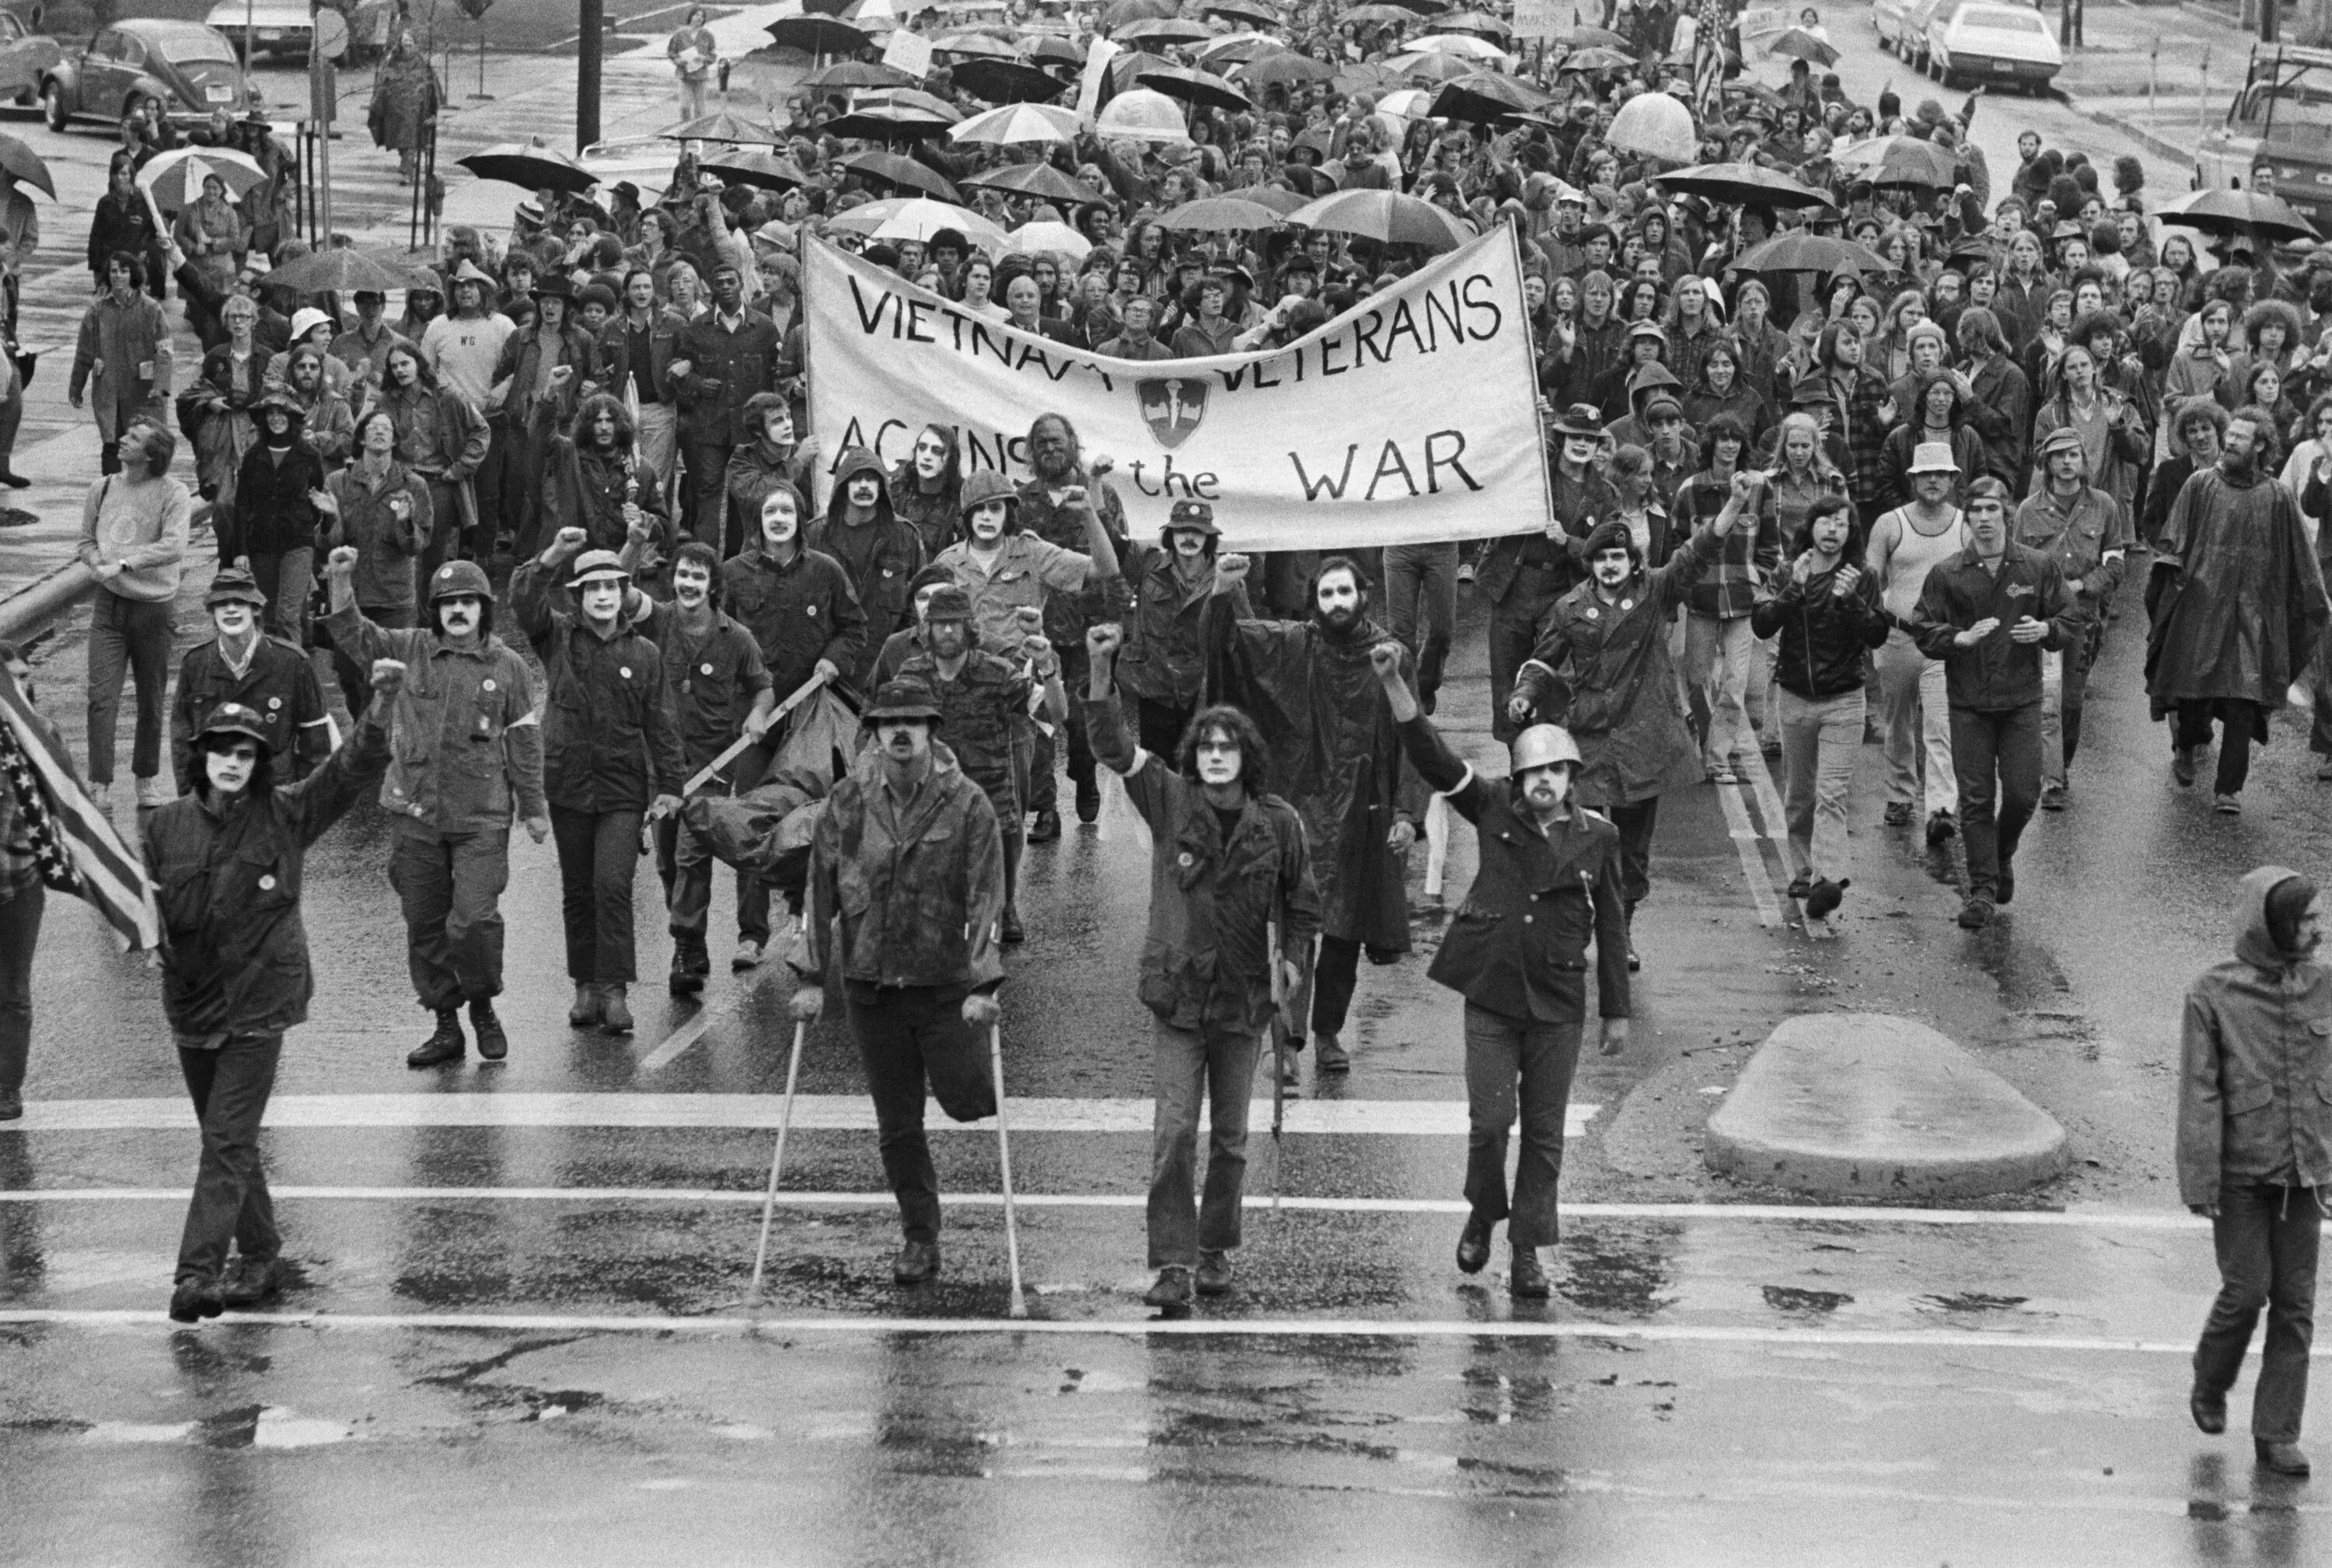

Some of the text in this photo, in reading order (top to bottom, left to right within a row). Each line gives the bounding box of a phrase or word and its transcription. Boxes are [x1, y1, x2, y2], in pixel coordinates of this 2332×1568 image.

[1213, 274, 1501, 391] VETERANS
[1129, 455, 1220, 500] the
[1288, 430, 1484, 501] WAR
